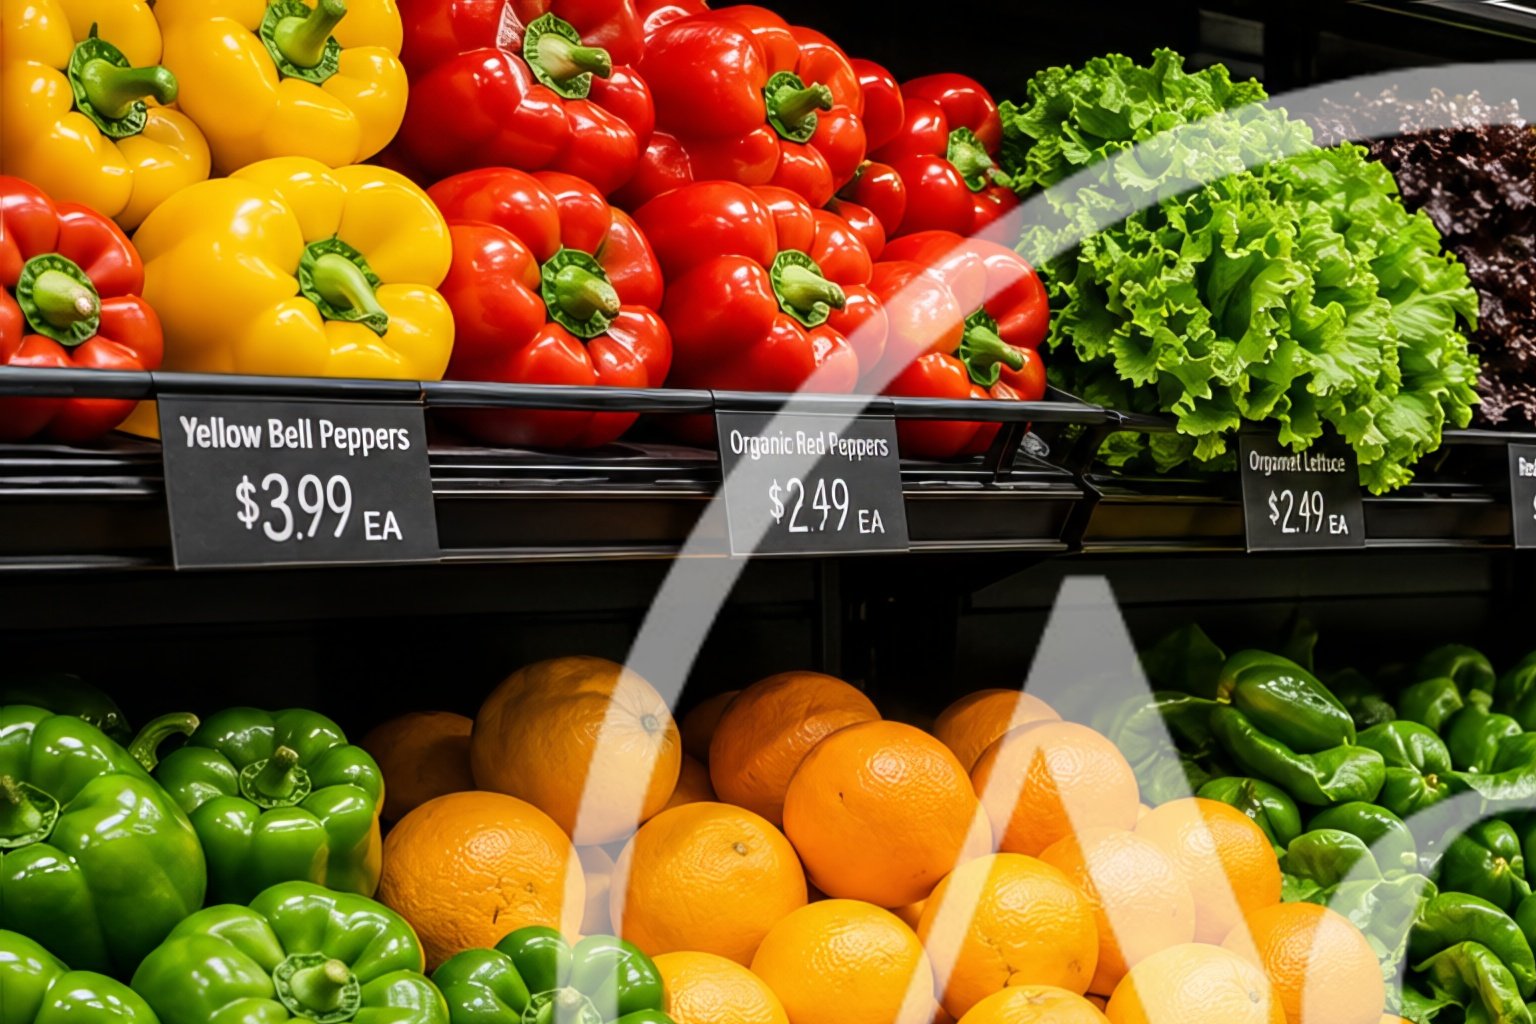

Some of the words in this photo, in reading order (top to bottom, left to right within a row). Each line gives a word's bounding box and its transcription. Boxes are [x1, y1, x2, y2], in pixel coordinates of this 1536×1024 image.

[179, 416, 262, 448] Yellow
[268, 418, 313, 449] Bell
[319, 419, 410, 456] Peppers
[730, 429, 794, 460] Organic
[796, 430, 825, 456] Red
[828, 431, 889, 461] Peppers
[235, 472, 352, 542] $3.99
[363, 510, 403, 541] EA
[768, 477, 849, 533] $2.49
[858, 509, 886, 534] EA
[1268, 489, 1324, 534] $2.49
[1328, 514, 1349, 535] EA
